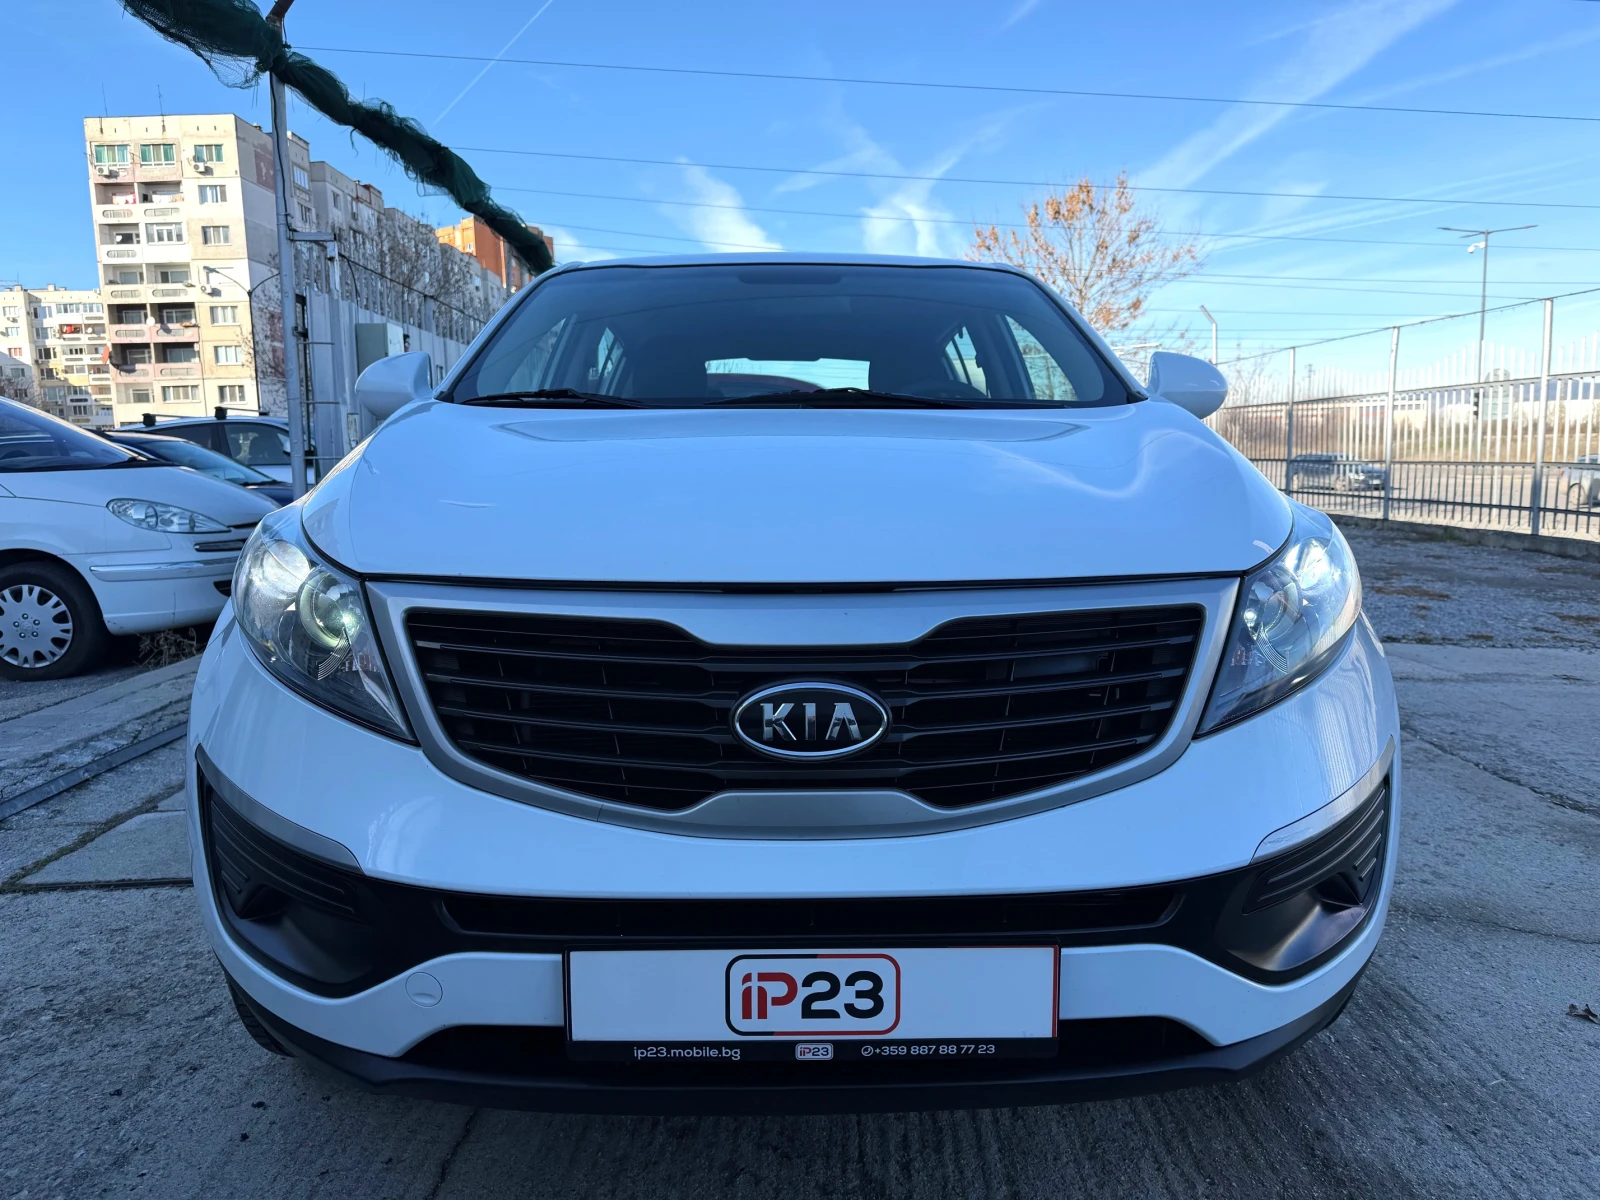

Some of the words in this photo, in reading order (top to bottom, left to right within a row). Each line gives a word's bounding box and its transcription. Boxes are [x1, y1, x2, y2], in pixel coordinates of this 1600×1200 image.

[760, 702, 863, 741] KIA
[633, 1046, 741, 1061] ip23.mobile.bg
[874, 1045, 907, 1055] +359
[910, 1045, 936, 1055] 887
[939, 1045, 957, 1055] 88
[960, 1044, 975, 1054] 77
[978, 1044, 996, 1054] 23
